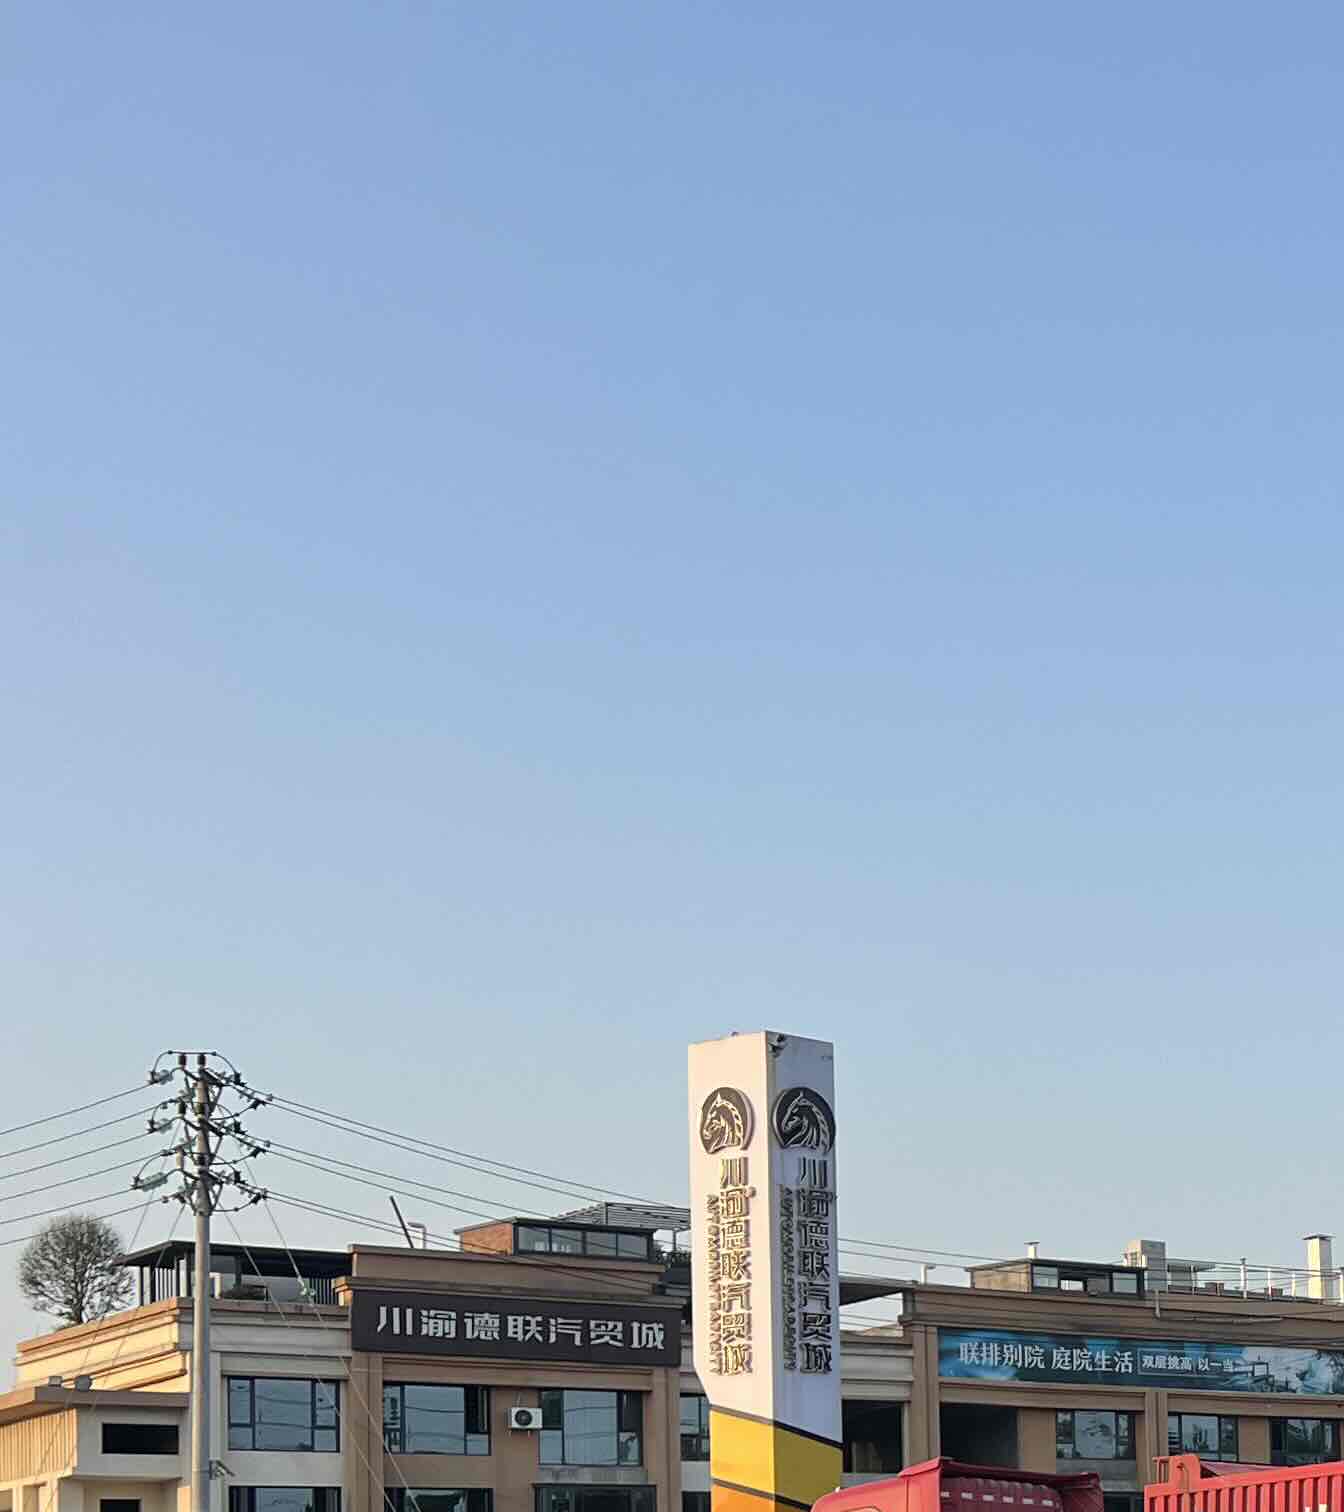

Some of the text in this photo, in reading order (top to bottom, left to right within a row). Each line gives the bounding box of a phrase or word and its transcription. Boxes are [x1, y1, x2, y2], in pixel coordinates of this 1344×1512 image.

[377, 1306, 665, 1350] 川渝德联汽贸城
[720, 1157, 752, 1376] 川渝德联汽贸城
[797, 1157, 833, 1376] 川渝德联汽贸城
[959, 1341, 1046, 1369] 联排别院
[1051, 1346, 1134, 1374] 庭院生活
